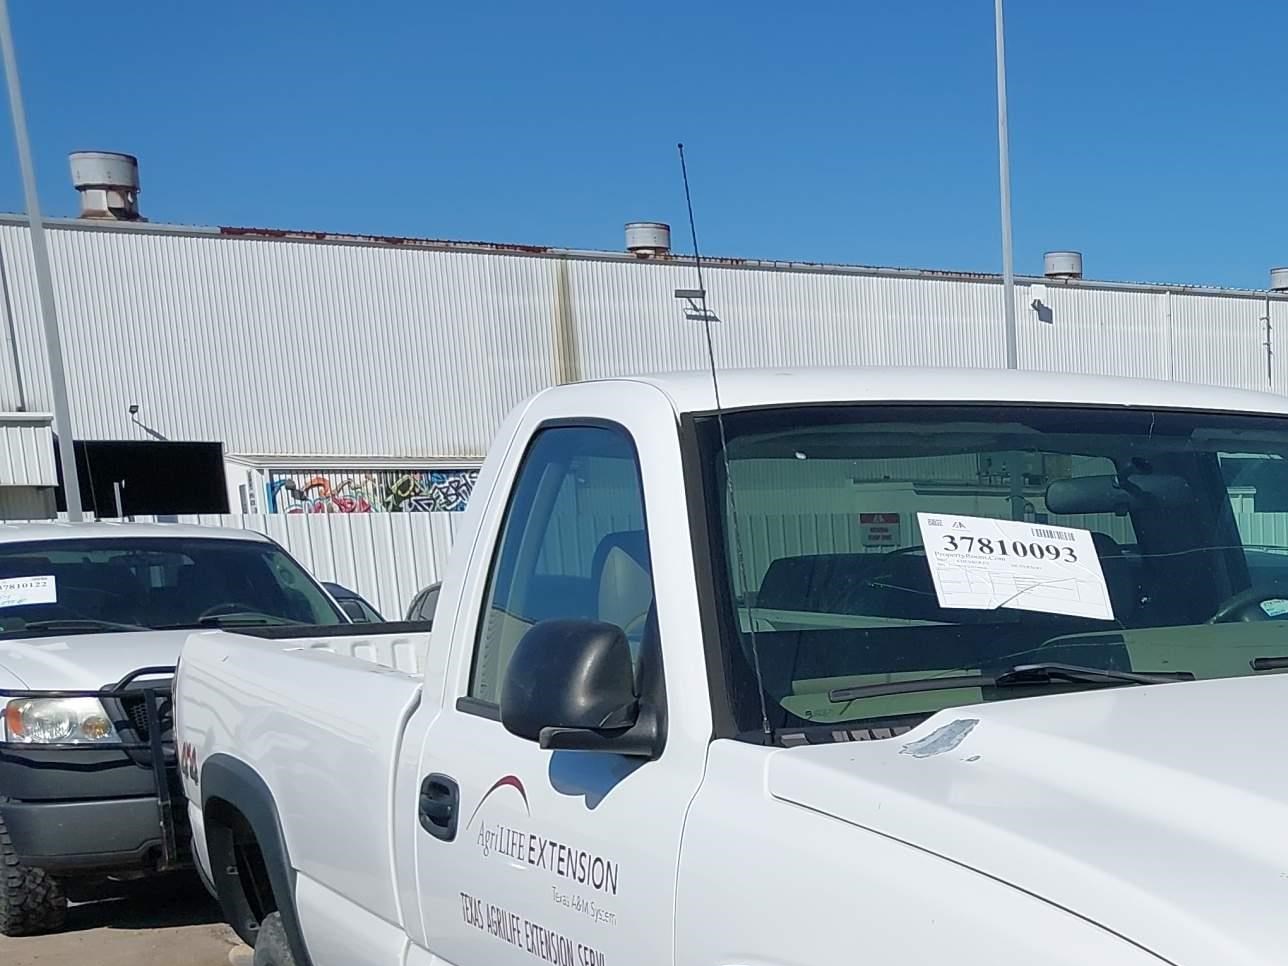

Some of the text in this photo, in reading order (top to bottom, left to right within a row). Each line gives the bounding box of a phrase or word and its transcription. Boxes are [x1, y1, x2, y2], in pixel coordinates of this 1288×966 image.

[941, 534, 1078, 564] 37810093
[477, 820, 619, 895] AgriLIFE EXTENSION
[460, 892, 484, 930] TEXAS
[486, 903, 523, 948] AGRILIFE
[551, 886, 617, 926] Texas A&M System
